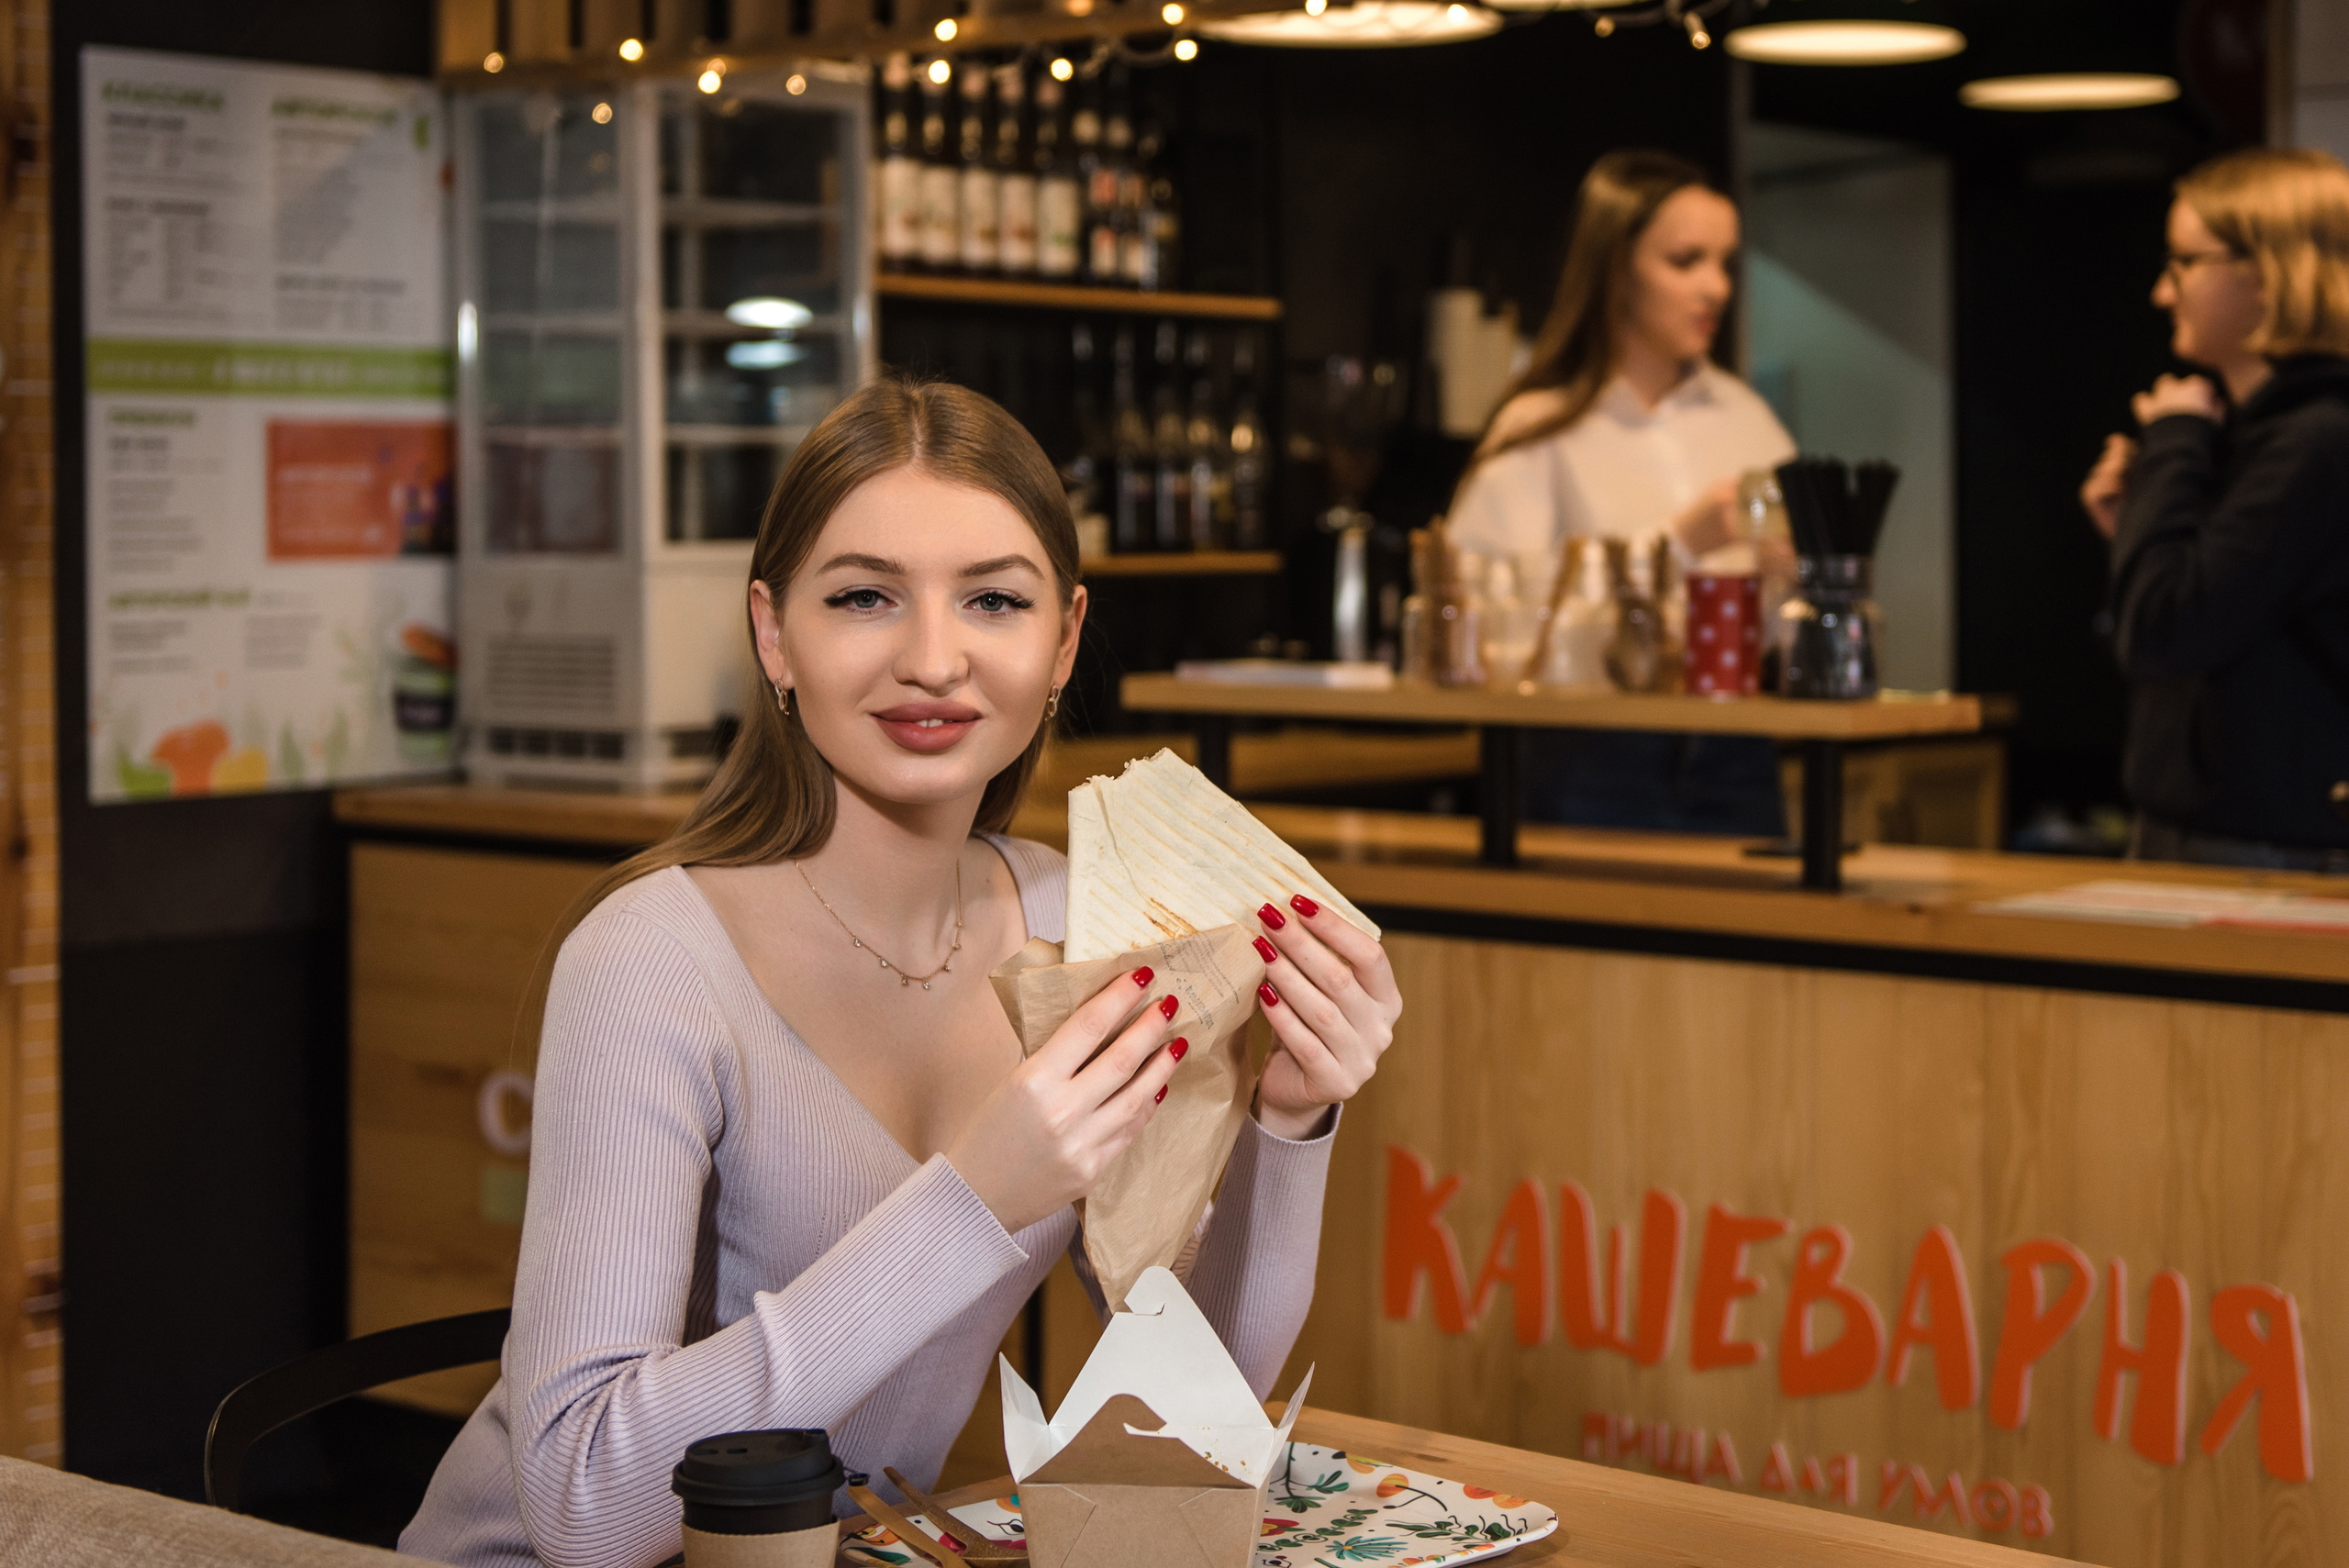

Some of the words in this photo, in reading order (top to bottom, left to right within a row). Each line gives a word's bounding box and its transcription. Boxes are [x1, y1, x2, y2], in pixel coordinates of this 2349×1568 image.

[1382, 1143, 2313, 1484] КАШЕВАРНЯ
[1582, 1411, 1743, 1485] ПИЩА
[1758, 1440, 1859, 1507] ДЛЯ
[1876, 1458, 2055, 1540] УМОВ
